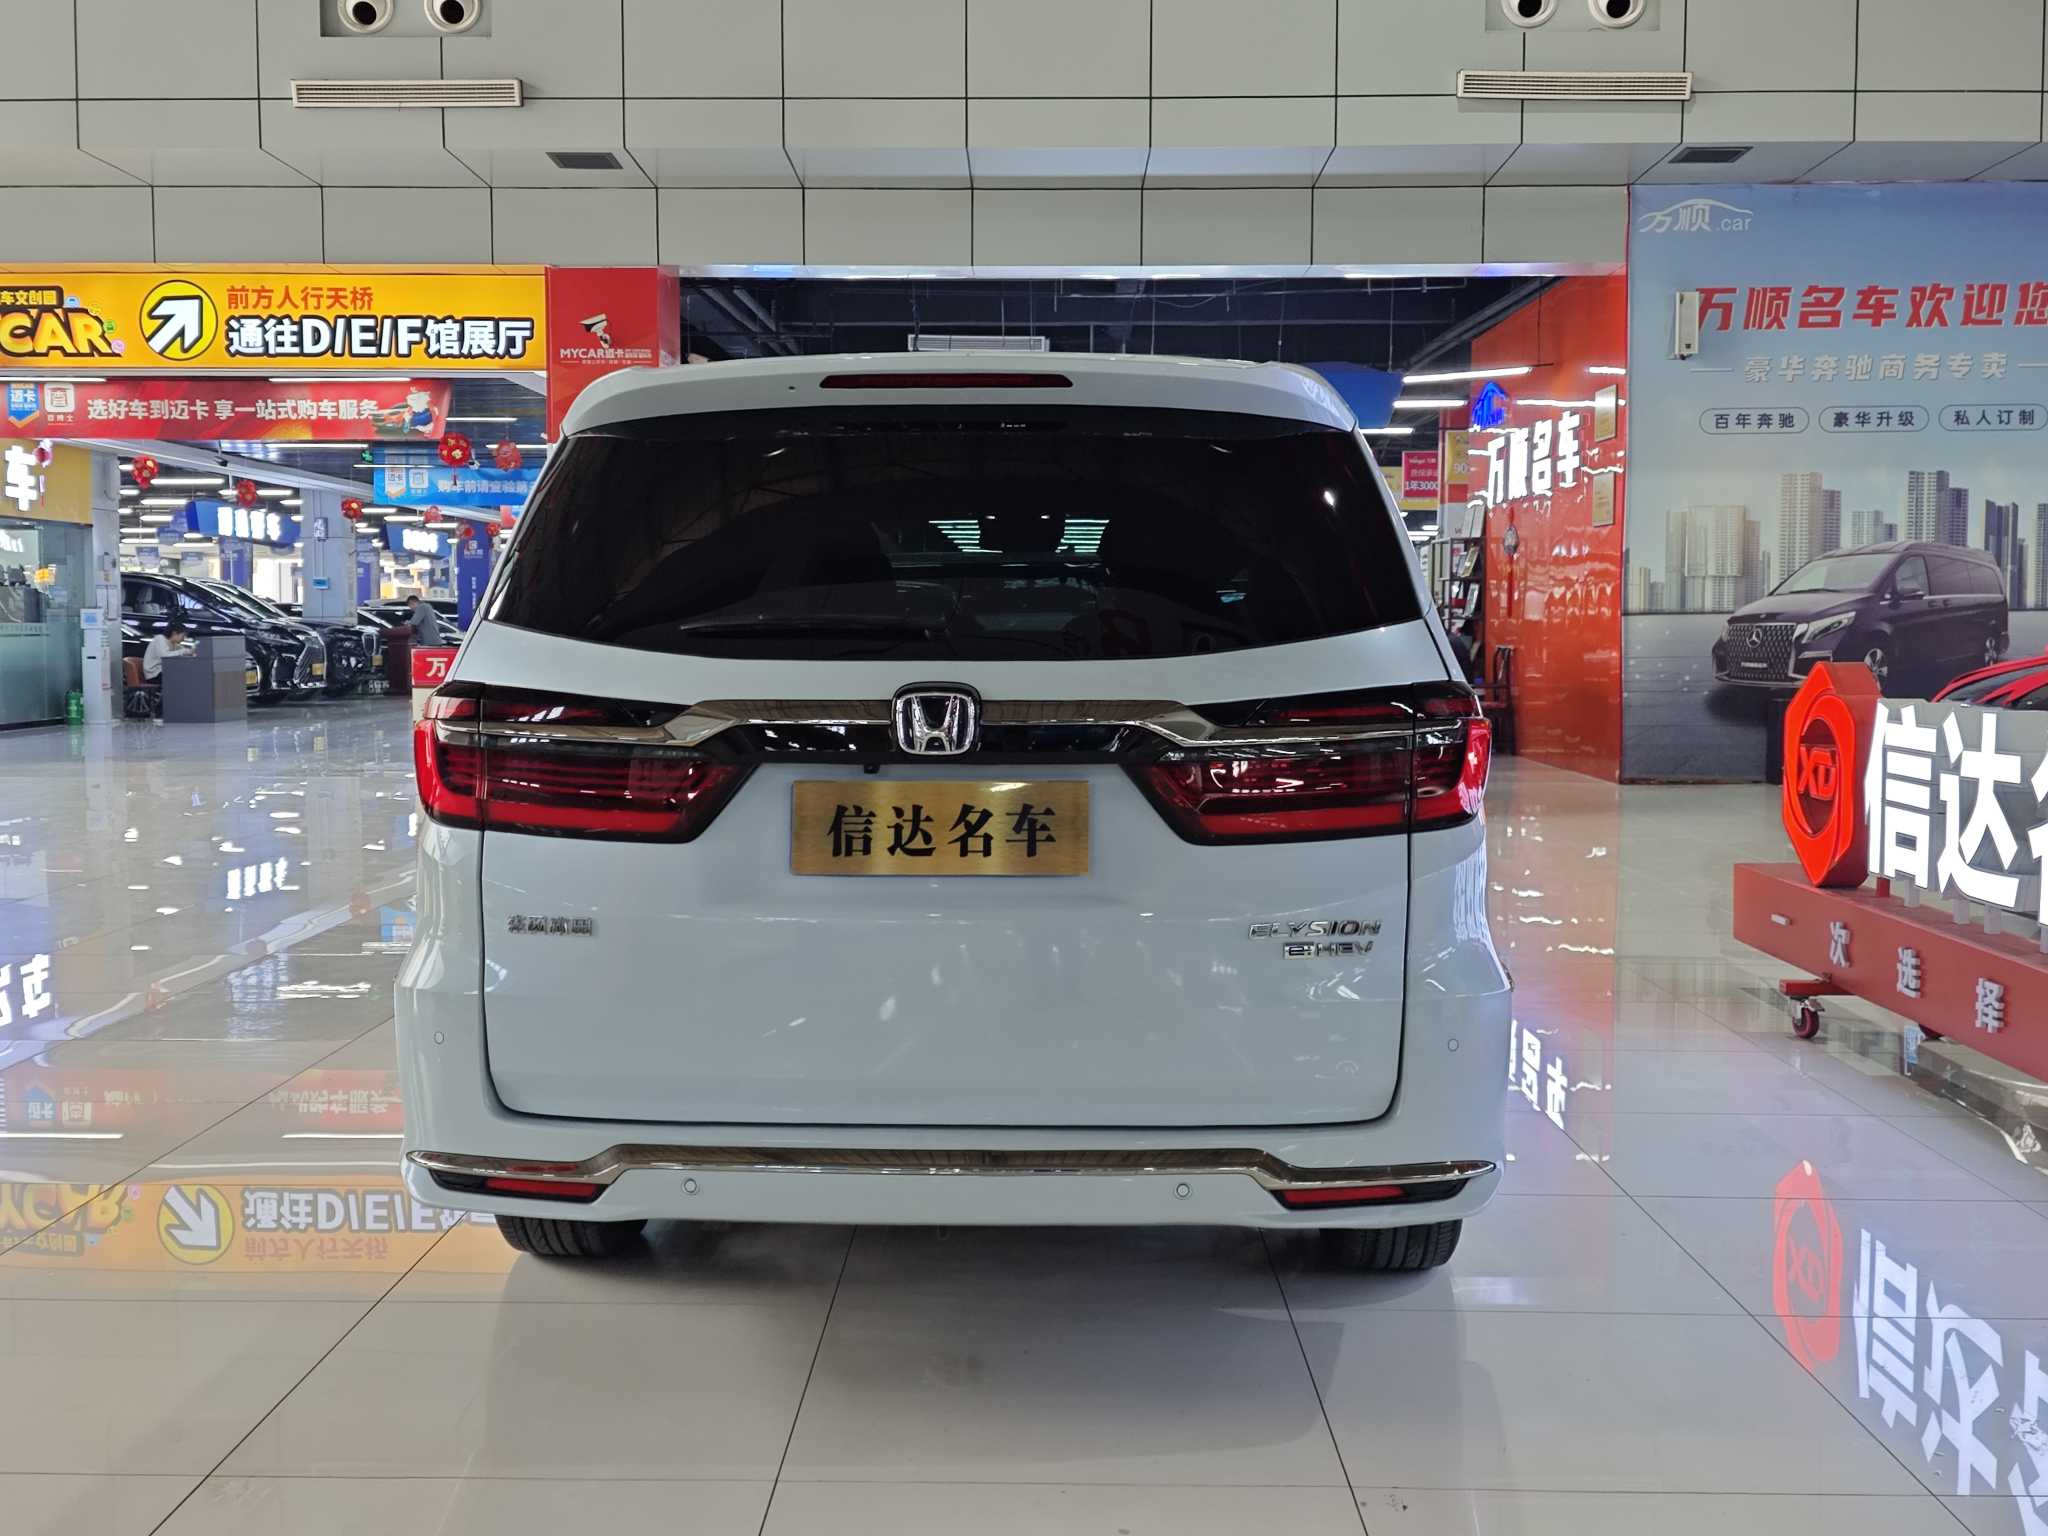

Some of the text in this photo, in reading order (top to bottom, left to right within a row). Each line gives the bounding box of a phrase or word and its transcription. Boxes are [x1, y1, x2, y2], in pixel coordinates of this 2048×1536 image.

[226, 286, 373, 310] 前方人行天桥
[1694, 281, 2048, 332] 万顺名车欢迎您
[227, 317, 532, 357] 通往D/E/F馆展厅
[1744, 352, 2007, 382] 豪华奔驰商务专卖
[87, 399, 380, 421] 选好车到迈卡 享一站式购车服务
[1714, 409, 2035, 430] 百年奔驰 豪华升级 私人订制
[426, 658, 448, 677] 万
[1864, 698, 2048, 925] 信达
[827, 803, 1056, 858] 信达名车
[1249, 920, 1381, 939] ELYSION
